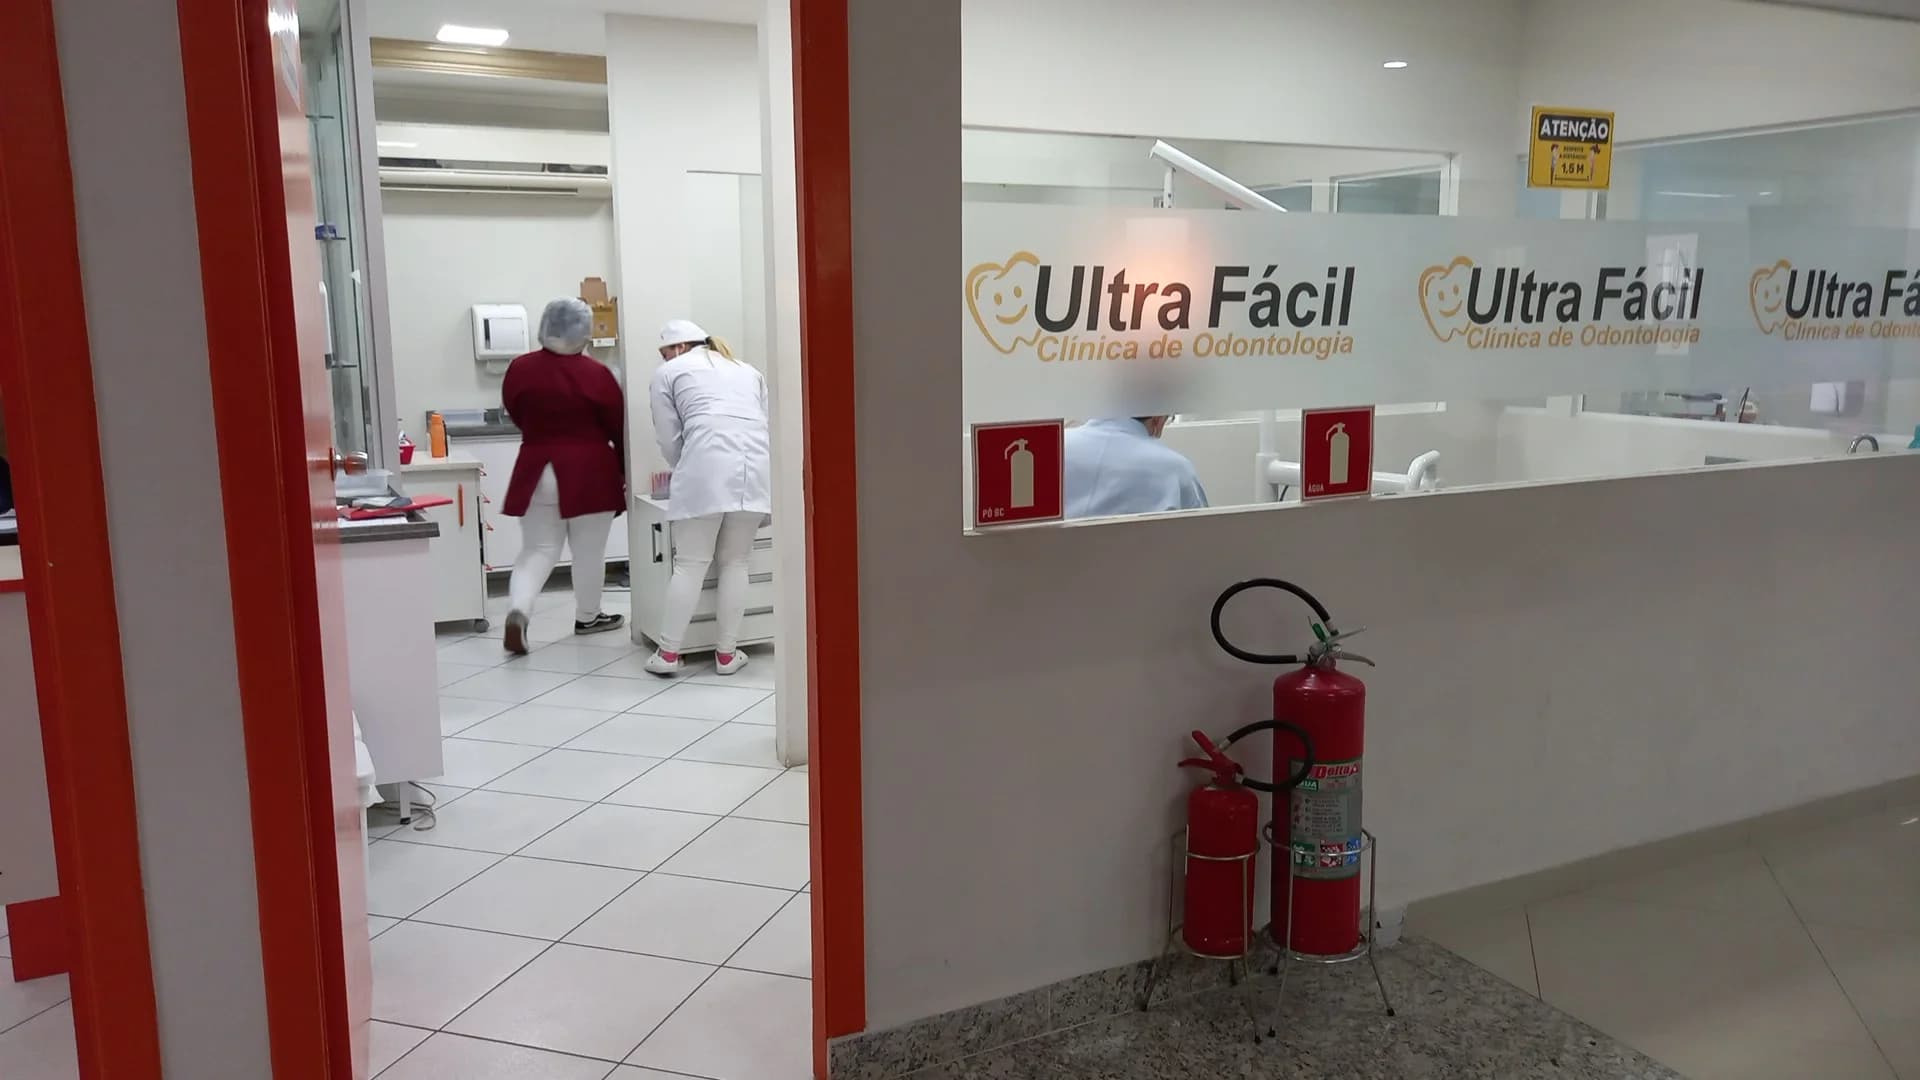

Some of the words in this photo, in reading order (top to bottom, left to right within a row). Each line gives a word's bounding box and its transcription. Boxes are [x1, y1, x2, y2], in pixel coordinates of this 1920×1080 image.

[1540, 118, 1609, 141] ATENÇÃO
[1576, 163, 1585, 174] M
[1035, 265, 1191, 332] Ultra
[1208, 265, 1355, 328] Fácil
[1467, 267, 1582, 324] Ultra
[1593, 266, 1704, 321] Fácil
[1785, 269, 1873, 319] Ultra
[1548, 325, 1574, 347] de
[1580, 323, 1701, 350] Odontologia
[1845, 320, 1865, 338] de
[1037, 334, 1138, 362] Clínica
[1148, 334, 1183, 359] de
[1192, 331, 1354, 360] Odontologia
